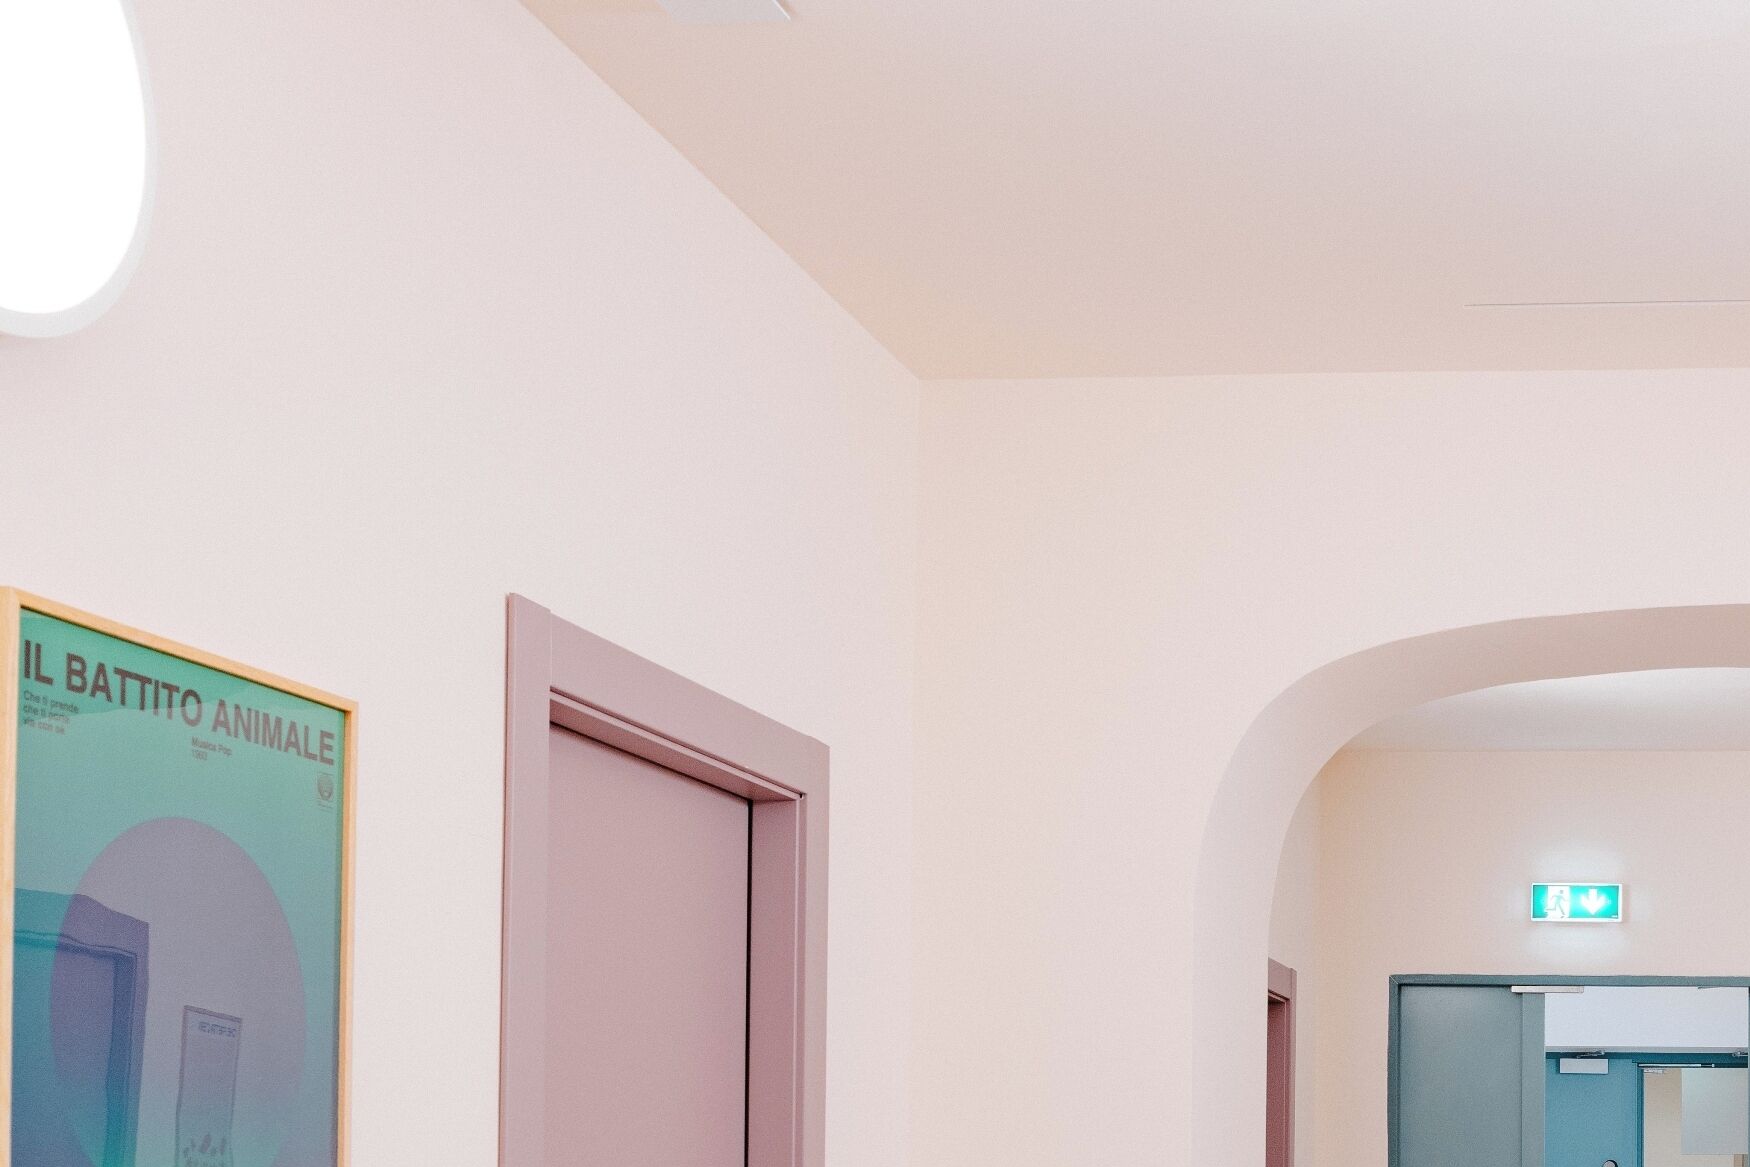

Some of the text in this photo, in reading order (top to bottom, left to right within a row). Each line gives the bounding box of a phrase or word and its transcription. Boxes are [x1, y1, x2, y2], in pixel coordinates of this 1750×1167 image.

[24, 639, 335, 766] IL BATTITO ANIMALE
